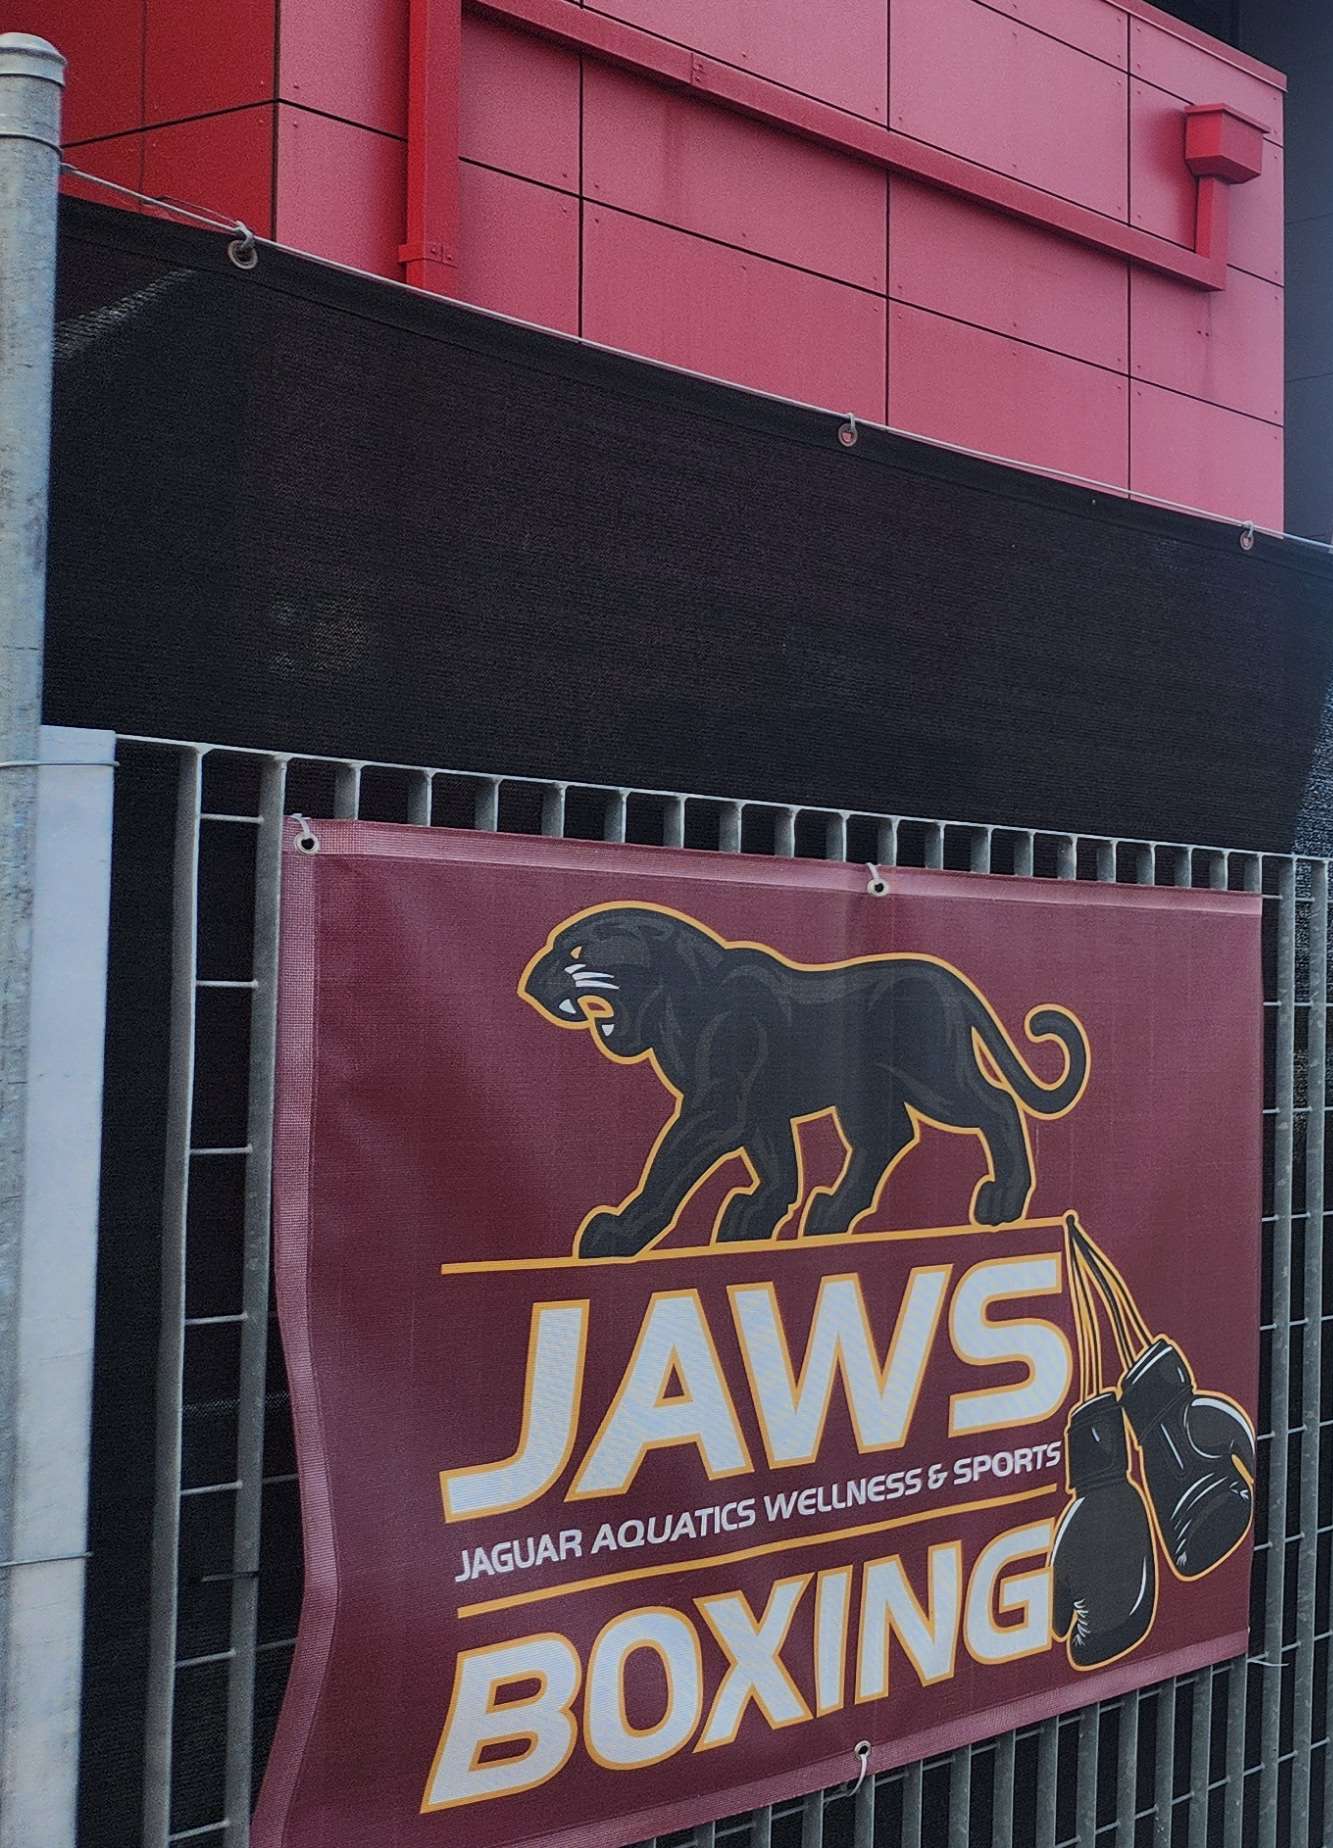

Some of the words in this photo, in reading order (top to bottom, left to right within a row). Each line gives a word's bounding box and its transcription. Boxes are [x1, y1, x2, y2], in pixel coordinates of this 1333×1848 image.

[440, 1251, 1073, 1524] JAWS
[454, 1528, 583, 1583] JAGUAR
[590, 1497, 756, 1555] AQUATICS
[763, 1467, 923, 1523] WELLNESS
[926, 1462, 949, 1491] &
[952, 1440, 1062, 1486] SPORTS
[420, 1516, 1056, 1815] BOXING
